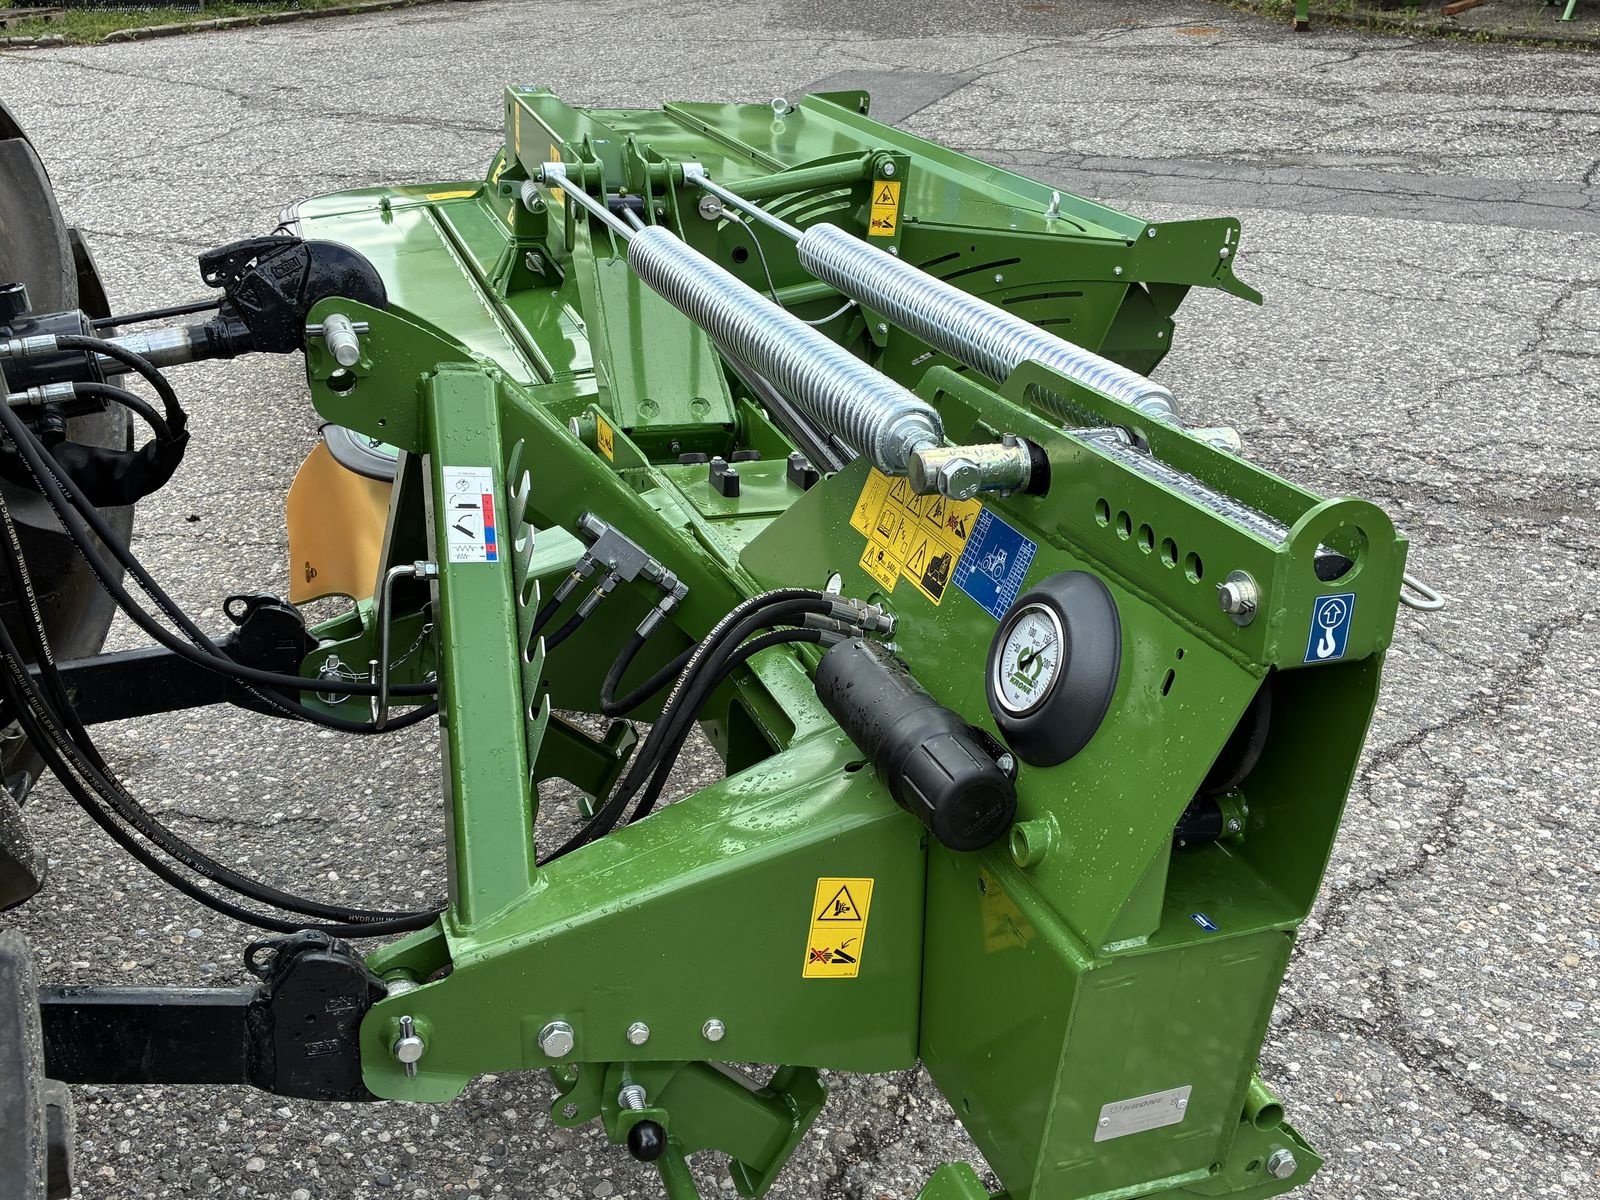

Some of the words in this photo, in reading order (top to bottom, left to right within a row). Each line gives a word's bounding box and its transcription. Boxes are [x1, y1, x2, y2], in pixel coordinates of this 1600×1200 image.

[0, 506, 12, 523] 2SC
[7, 524, 20, 549] EN857
[15, 552, 31, 584] RHEINE
[25, 585, 42, 622] MUELLER
[36, 622, 55, 665] HYDRAULIK
[661, 668, 690, 715] HYDRAULIK
[687, 633, 714, 672] MUELLER
[712, 612, 736, 639] RHEINE
[1009, 676, 1033, 695] KRONE
[3, 652, 33, 696] HYDRAULIK
[28, 695, 55, 732] MUELLER
[50, 730, 73, 757] RHEINE
[71, 757, 91, 779] EN857
[87, 776, 103, 792] 2SC
[133, 820, 150, 836] MAX
[150, 833, 163, 846] WP
[173, 850, 190, 865] BAR
